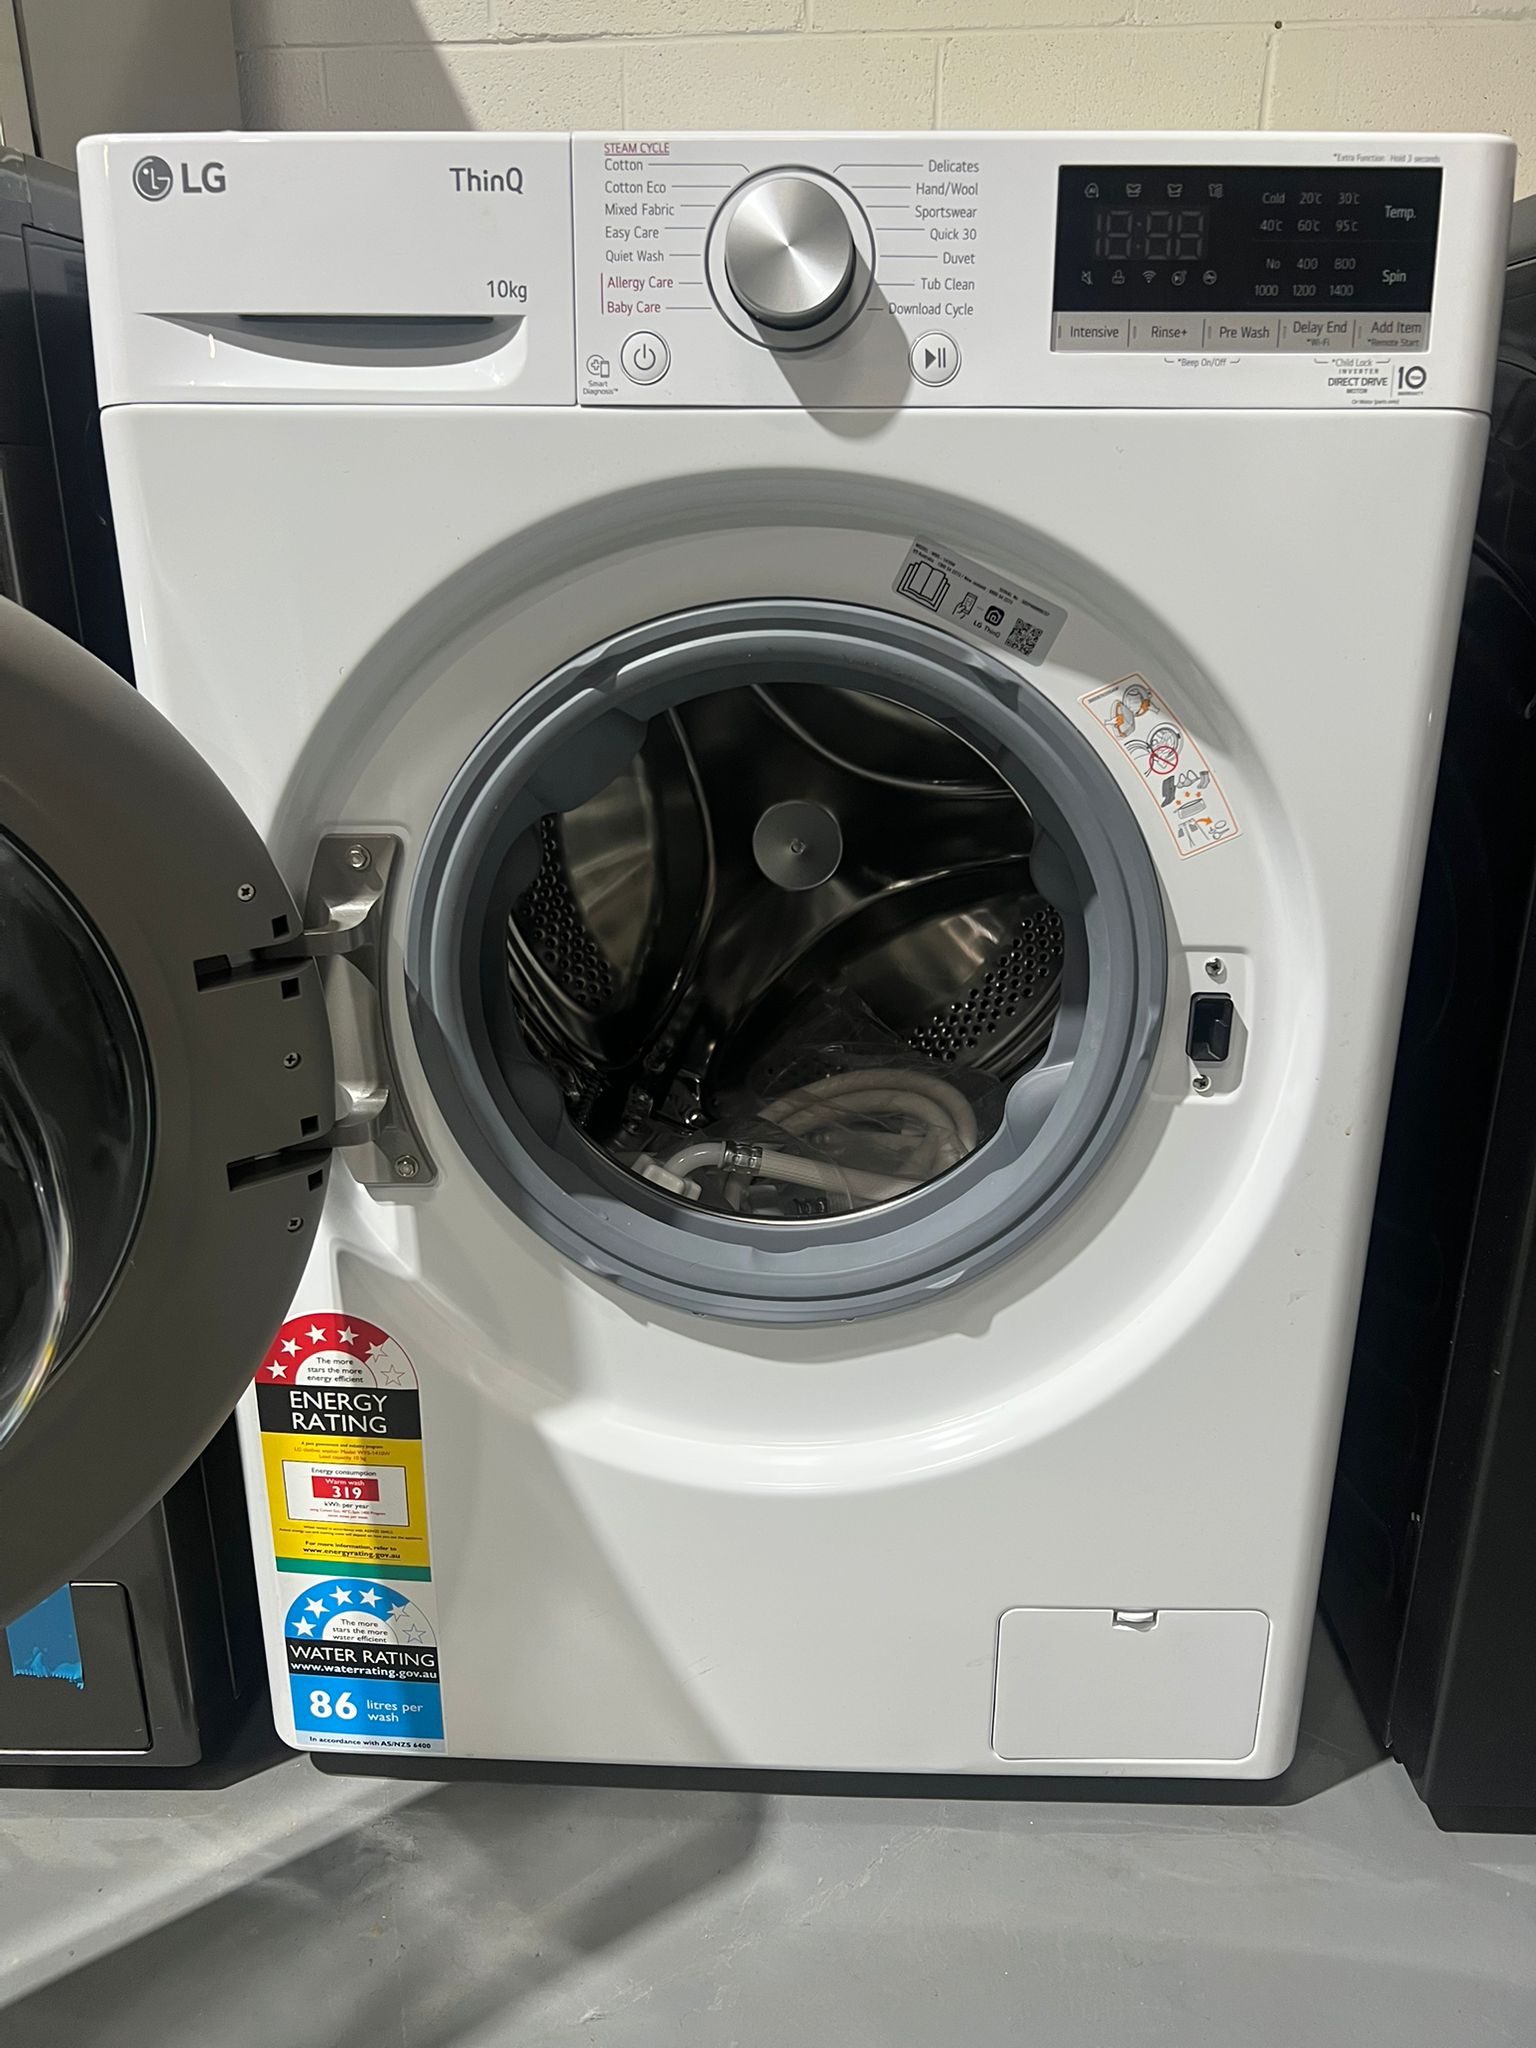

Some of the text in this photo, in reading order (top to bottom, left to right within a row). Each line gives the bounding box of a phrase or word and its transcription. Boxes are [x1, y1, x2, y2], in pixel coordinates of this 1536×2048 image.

[604, 142, 670, 154] STEAM CYCLE
[604, 159, 643, 171] Cotton
[928, 159, 980, 173] Delicates
[181, 161, 227, 194] LG
[449, 166, 524, 195] ThinQ
[604, 181, 667, 193] Cotton Eco
[915, 182, 979, 196] Hand/Wool
[1262, 192, 1286, 204] Cold
[605, 203, 675, 216] Mixed Fabric
[915, 205, 978, 221] Sportswear
[1384, 205, 1417, 222] Temp.
[605, 226, 660, 240] Easy Care
[929, 228, 977, 242] Quick 30
[605, 250, 664, 263] Quiet Wash
[942, 251, 976, 265] Duvet
[1266, 258, 1356, 270] No 400 800
[607, 276, 674, 291] Allergy Care
[1381, 269, 1407, 286] Spin
[486, 279, 528, 303] 10kg
[920, 278, 975, 291] Tub Clean
[1255, 284, 1354, 297] 1000 1200 1400
[607, 301, 662, 316] Baby Care
[888, 301, 974, 318] Download Cycle
[1070, 325, 1119, 339] Intensive
[1151, 325, 1188, 339] Rinse+
[1219, 325, 1270, 340] Pre Wash
[1292, 321, 1347, 336] Delay End
[1371, 321, 1422, 334] Add Item
[1400, 338, 1420, 347] Start
[1201, 358, 1227, 367] On/Off
[1356, 358, 1373, 367] Lock
[1328, 377, 1388, 387] DIRECT DRIVE
[1398, 365, 1427, 389] 10
[588, 380, 608, 388] Smart
[973, 620, 1001, 639] LG ThinQ
[307, 1375, 332, 1383] energy
[289, 1390, 388, 1413] ENERGY
[291, 1412, 387, 1434] RATING
[311, 1467, 377, 1477] Energy consumption
[332, 1486, 362, 1499] 319
[335, 1542, 373, 1550] information,
[303, 1547, 401, 1559] www.energyrating.gov.au
[341, 1618, 355, 1626] The
[353, 1627, 368, 1635] the
[357, 1635, 387, 1643] efficient
[290, 1645, 435, 1667] WATER RATING
[290, 1662, 437, 1679] www.waterrating.gov.au
[309, 1689, 358, 1720] 86
[367, 1700, 424, 1713] litres per
[367, 1712, 399, 1722] wash
[319, 1737, 361, 1746] accordance
[363, 1738, 380, 1746] with
[381, 1739, 411, 1748] AS/NZS
